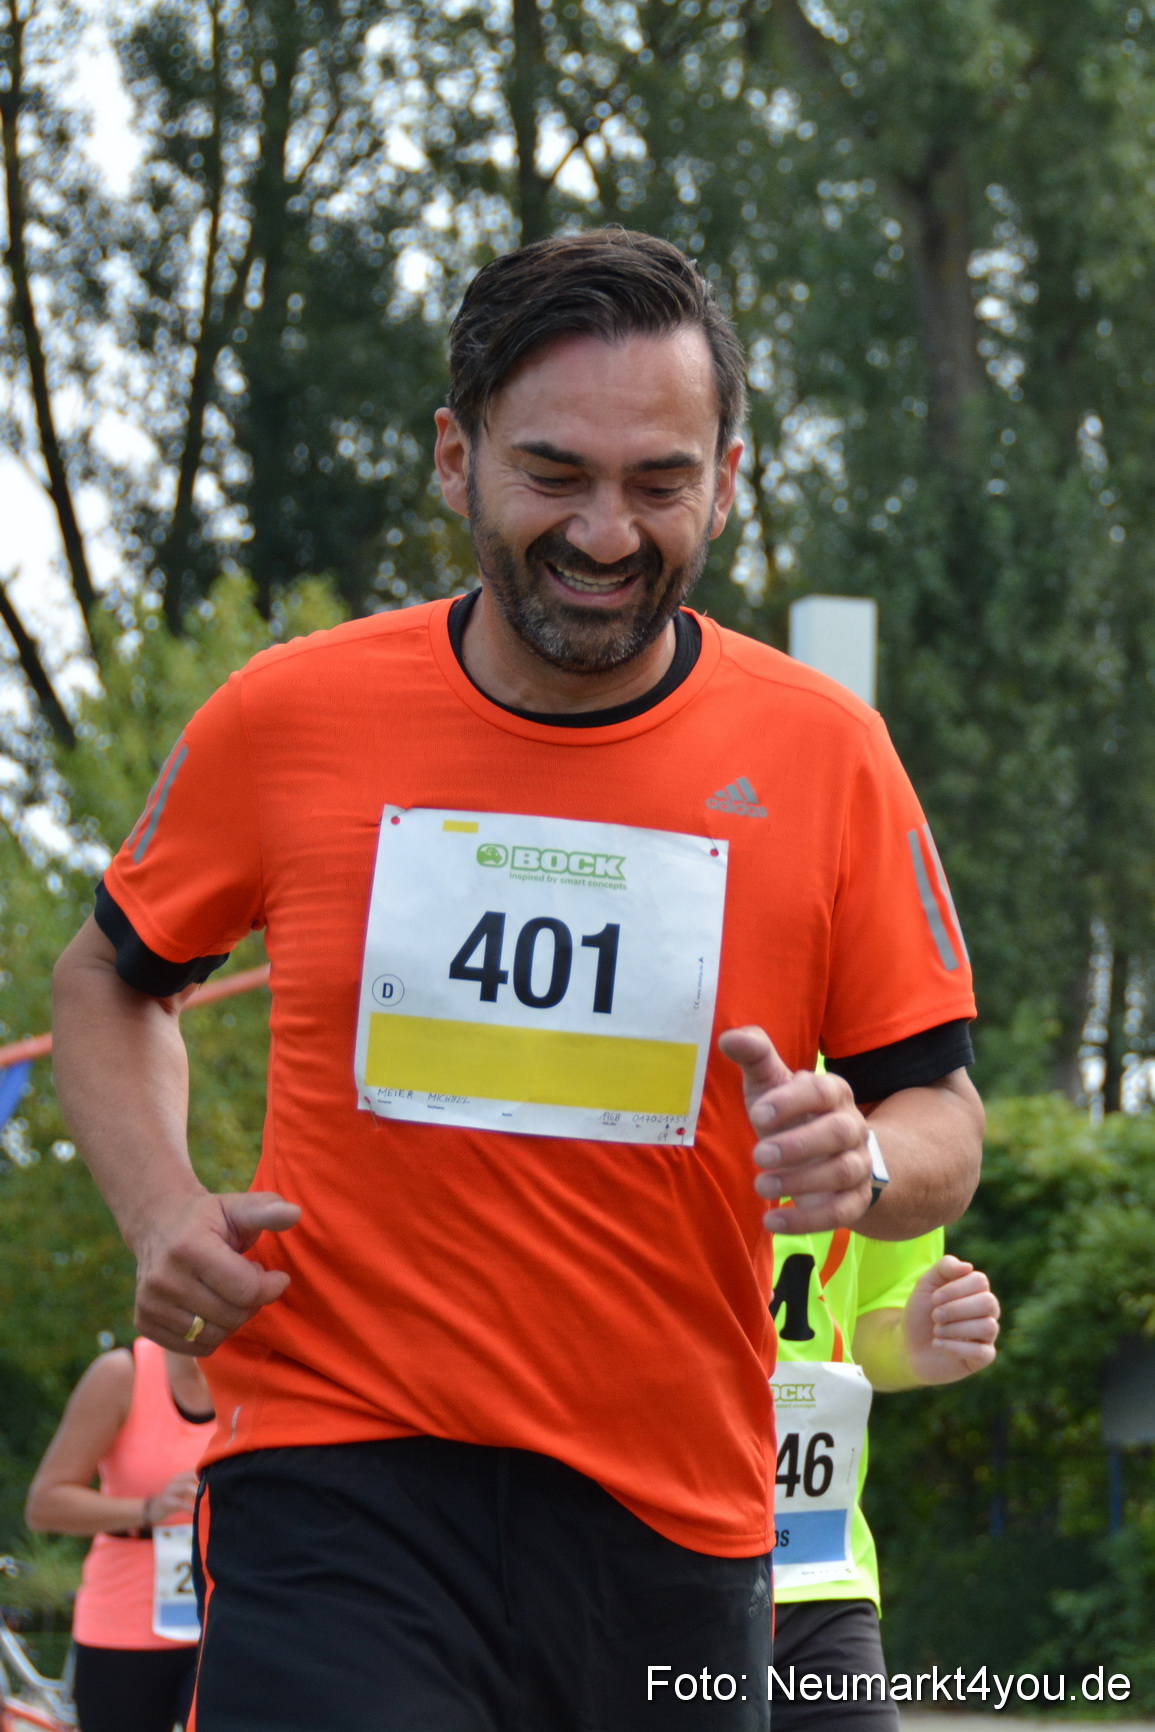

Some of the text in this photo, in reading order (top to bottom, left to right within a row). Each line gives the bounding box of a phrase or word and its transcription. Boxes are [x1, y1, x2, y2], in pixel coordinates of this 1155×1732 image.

[705, 798, 768, 818] adidas
[511, 845, 626, 880] BOCK
[509, 871, 627, 891] inspired by smart concepts
[448, 910, 621, 1015] 401
[382, 982, 394, 999] D
[377, 1088, 414, 1100] MEIER
[770, 1383, 816, 1402] OCK
[775, 1432, 834, 1498] 46
[174, 1561, 193, 1595] 2
